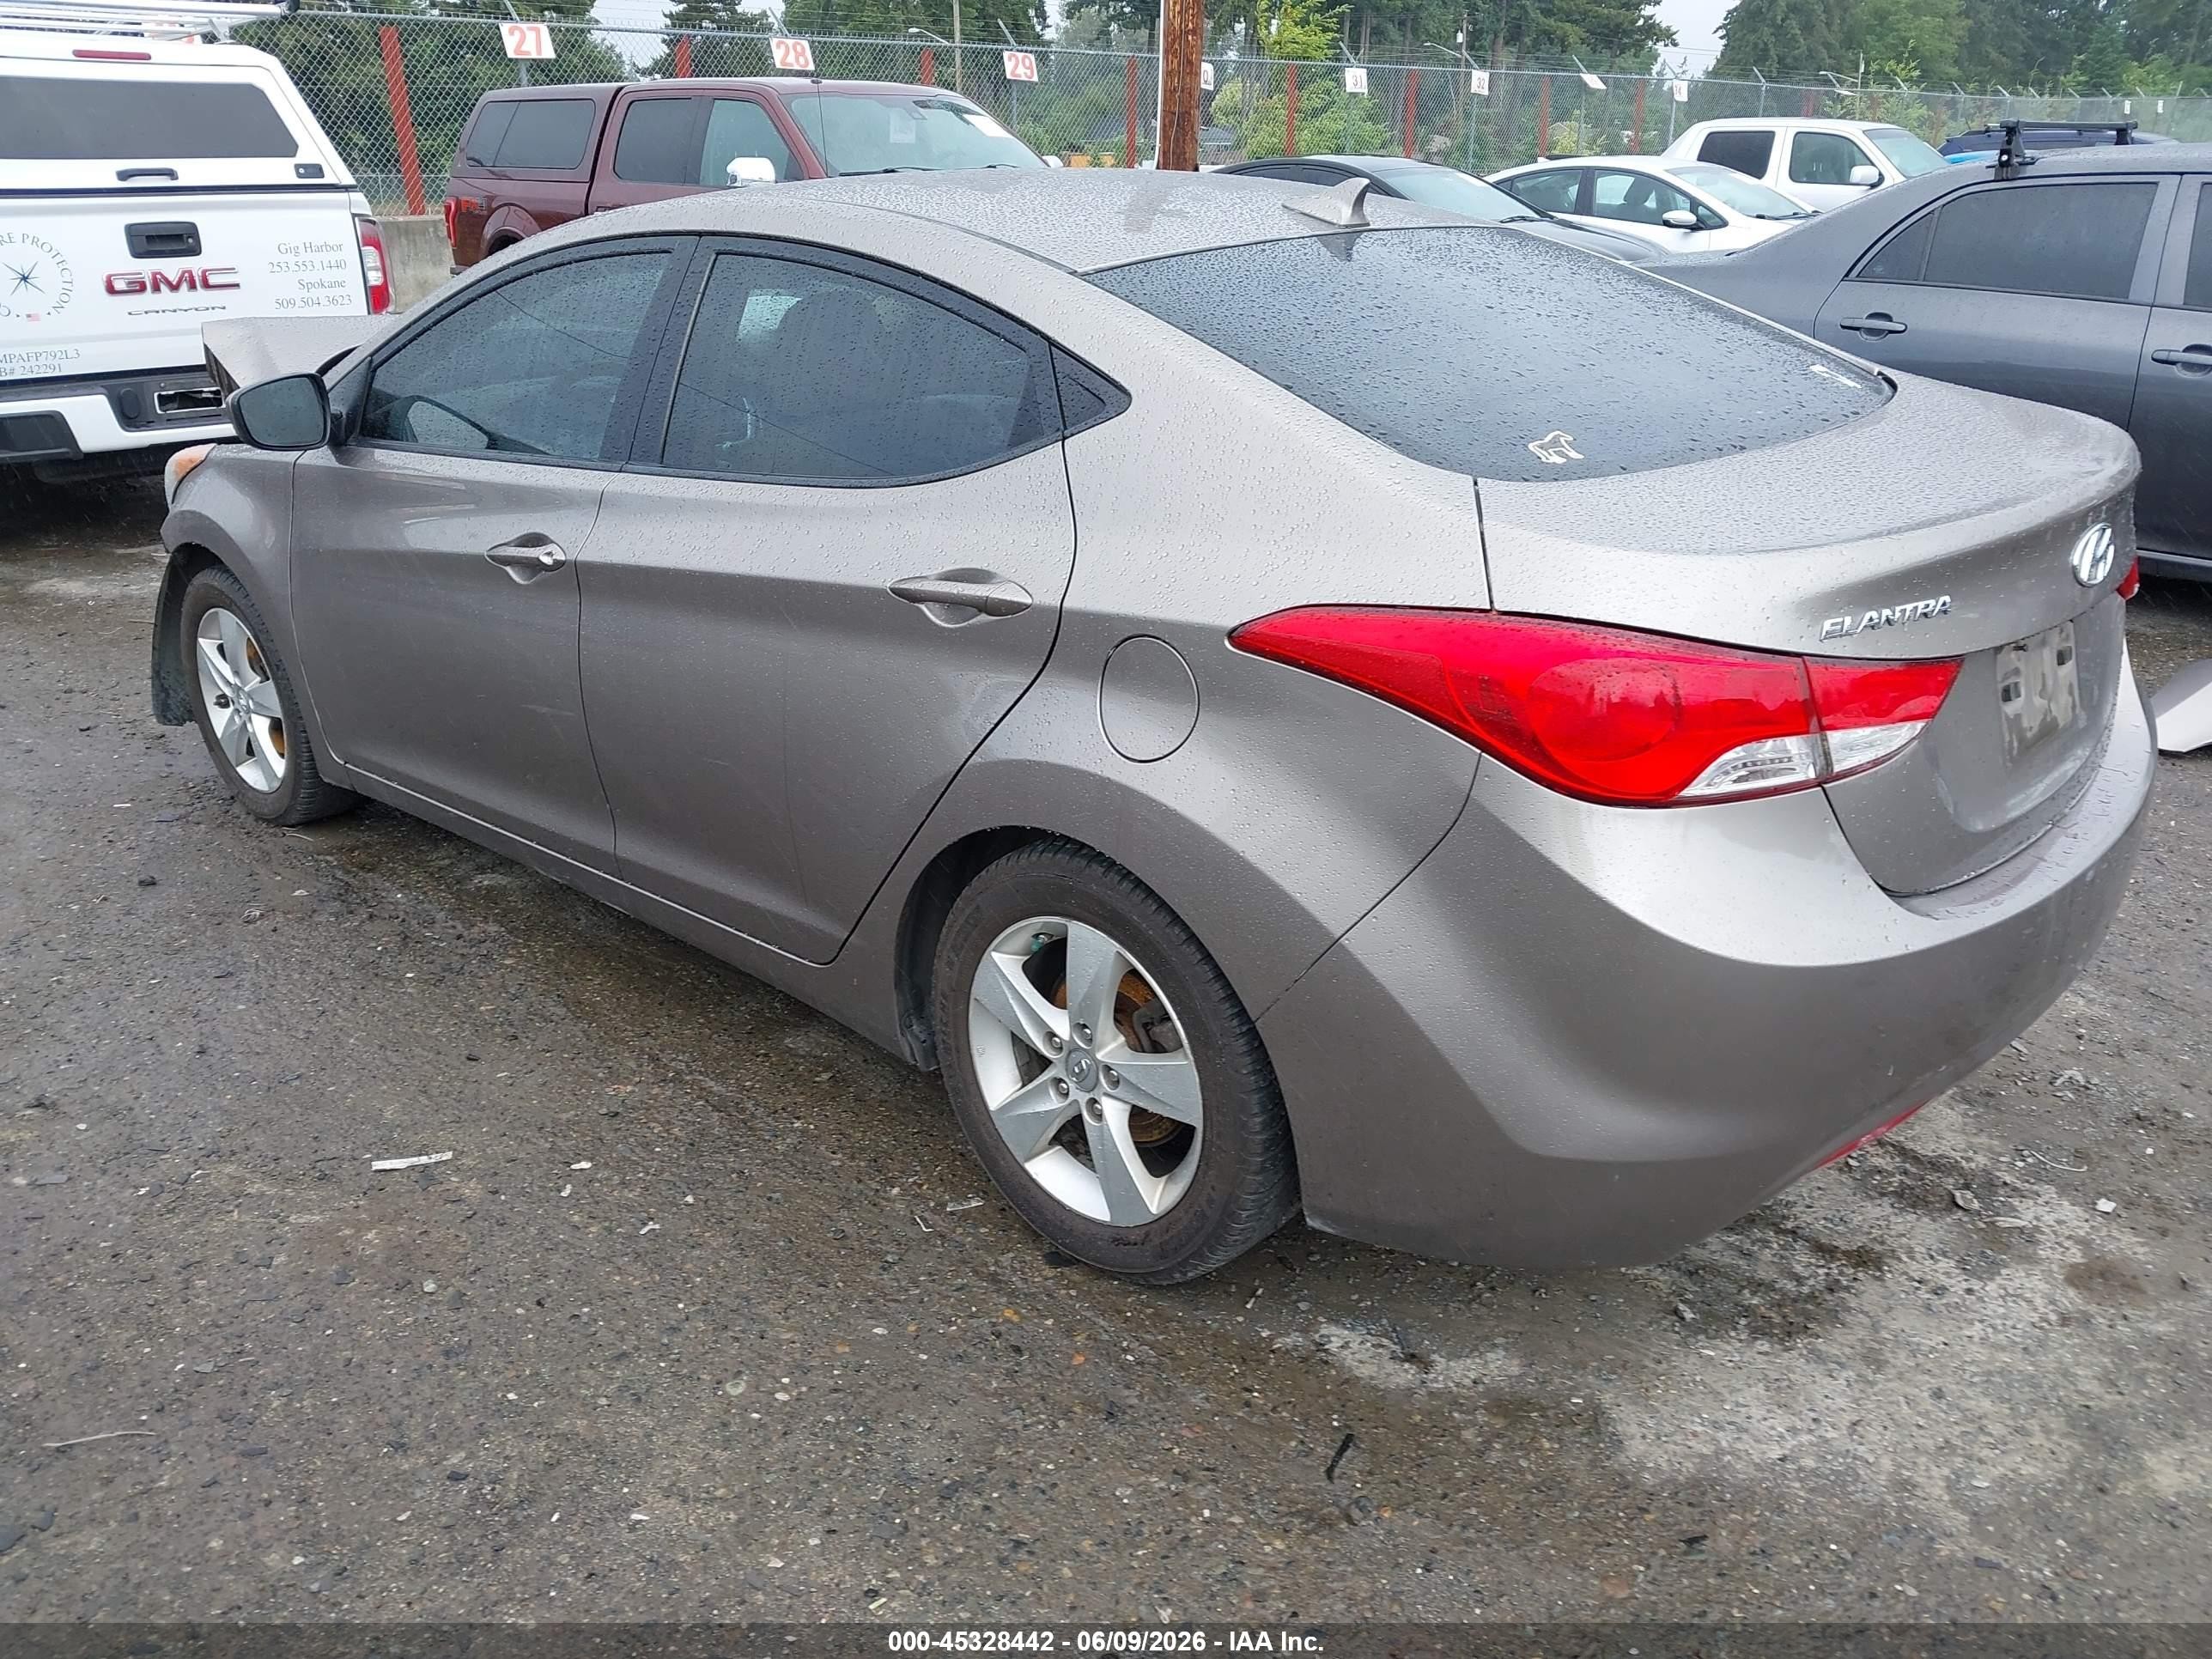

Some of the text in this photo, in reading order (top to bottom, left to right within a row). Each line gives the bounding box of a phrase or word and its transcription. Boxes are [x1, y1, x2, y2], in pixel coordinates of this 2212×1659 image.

[508, 25, 542, 56] 27
[775, 40, 809, 68] 28
[1007, 52, 1034, 79] 29
[1202, 70, 1209, 83] 0
[1477, 76, 1486, 89] 32
[277, 241, 343, 257] Gig Harbor
[267, 258, 347, 273] 253.553.1440
[21, 233, 74, 315] PROTECTION
[103, 266, 241, 296] GMC
[297, 277, 347, 293] Spokane
[275, 294, 352, 310] 509.504.3623
[128, 306, 226, 315] CANYON
[20, 363, 63, 375] 242291
[1820, 595, 1952, 642] ELANTRA
